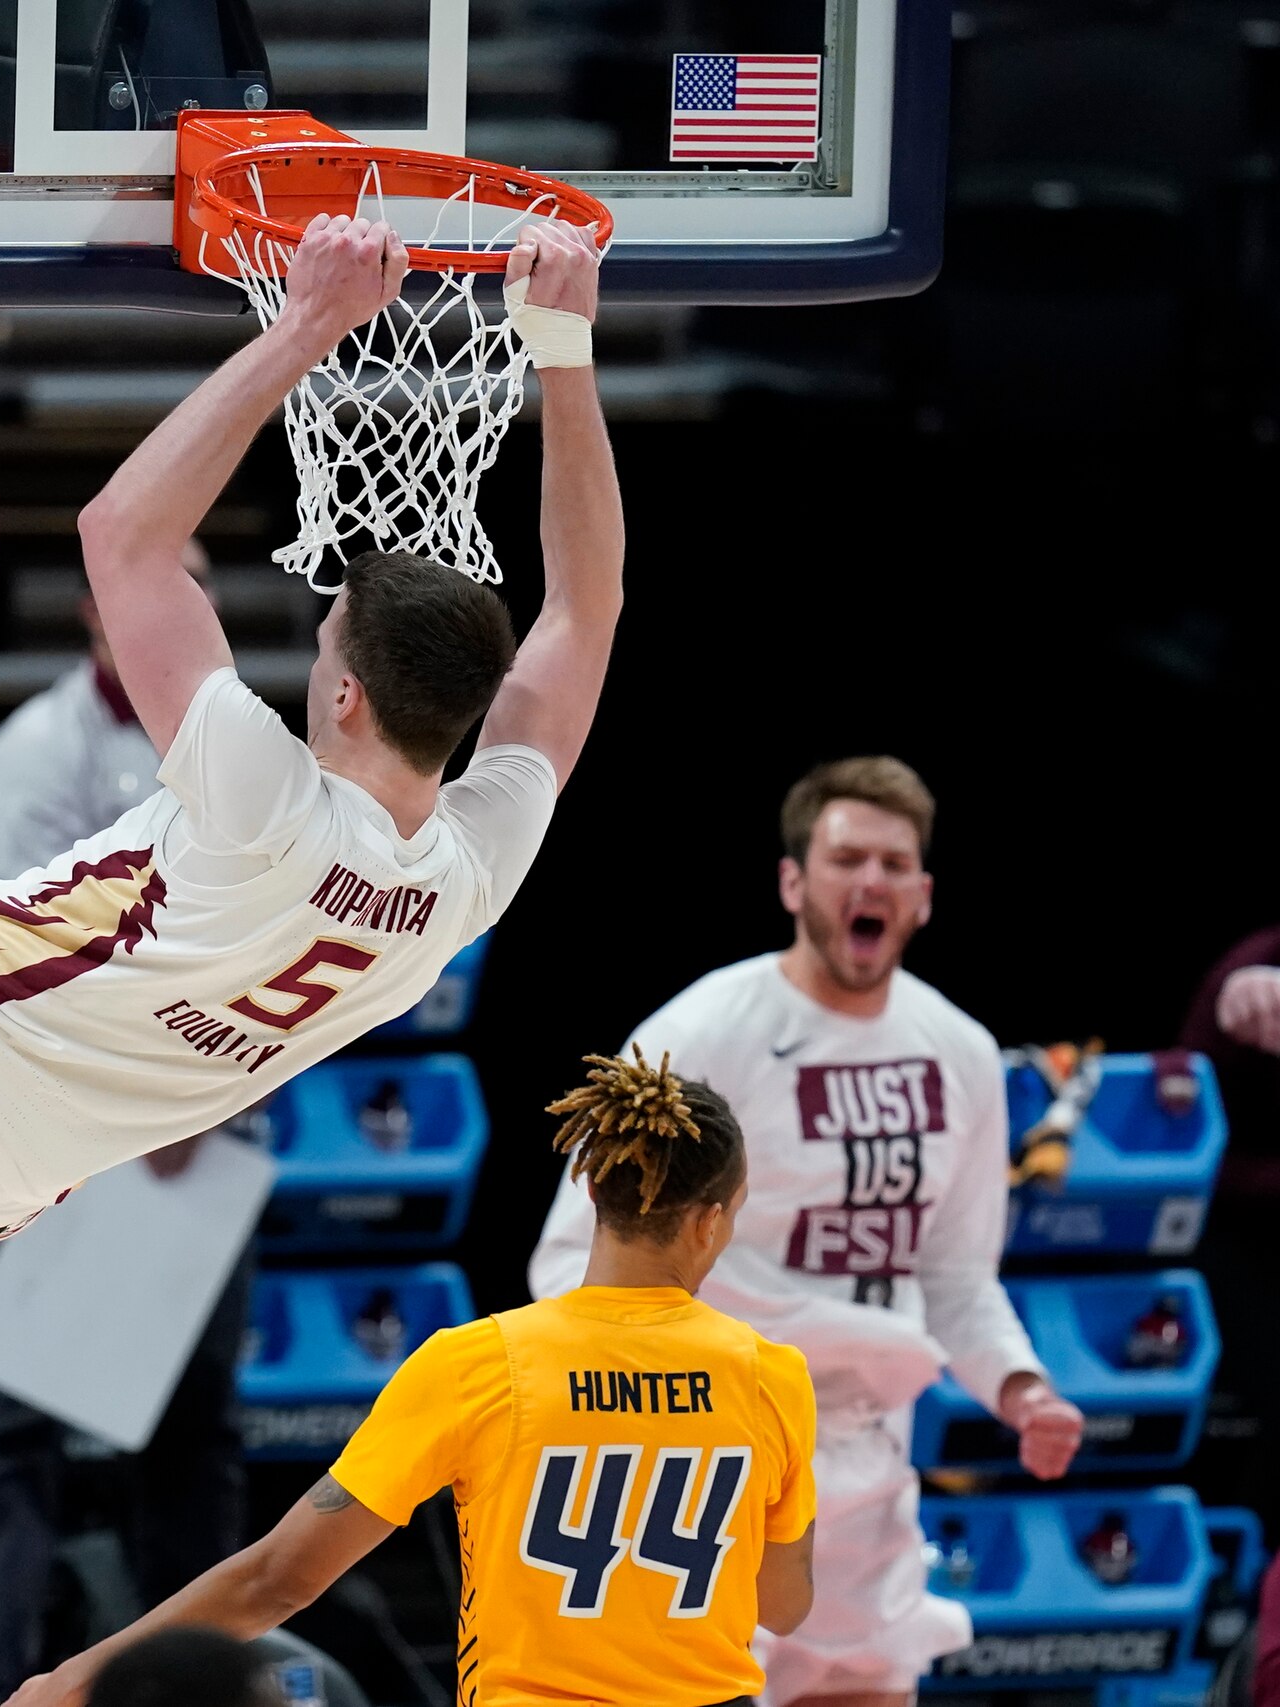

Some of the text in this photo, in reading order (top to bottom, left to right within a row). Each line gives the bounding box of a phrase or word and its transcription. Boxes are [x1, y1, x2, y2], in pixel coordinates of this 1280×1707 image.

[222, 936, 383, 1034] 5
[813, 1061, 929, 1137] JUST
[850, 1136, 917, 1205] US
[569, 1371, 713, 1413] HUNTER
[519, 1445, 752, 1619] 44
